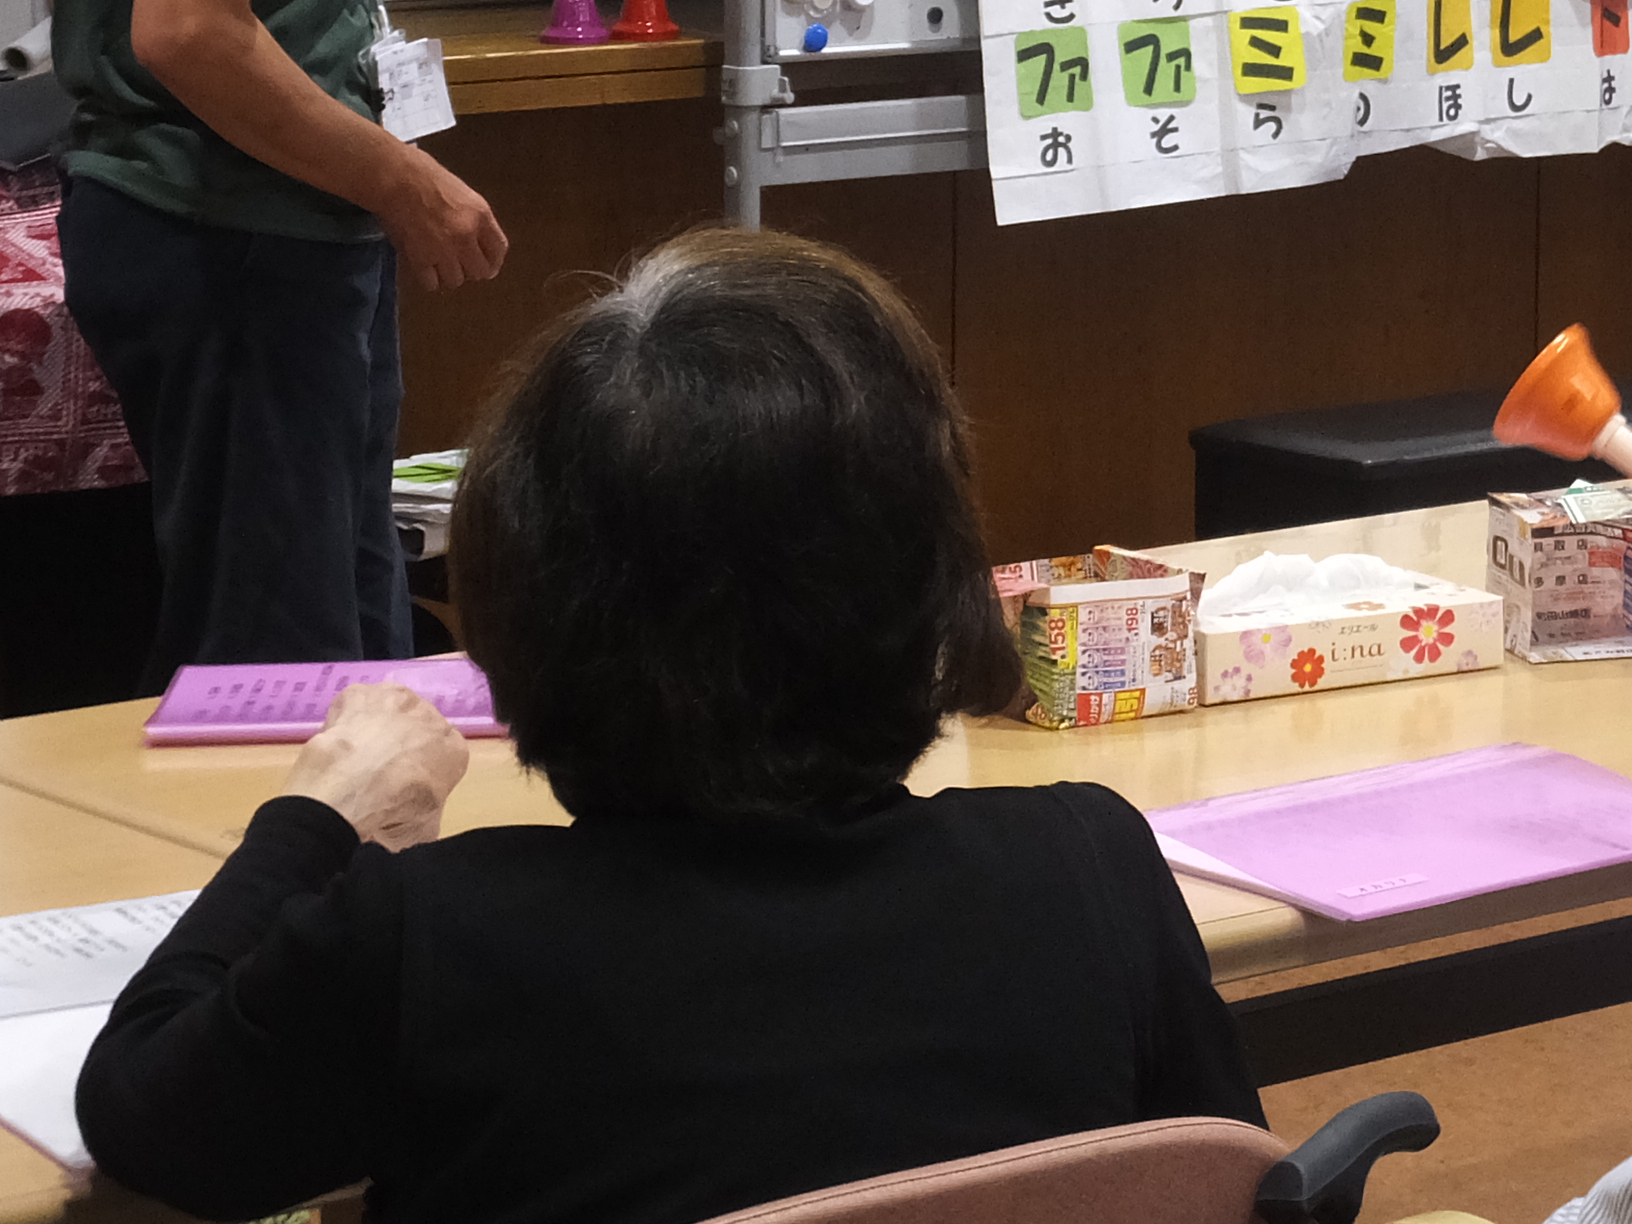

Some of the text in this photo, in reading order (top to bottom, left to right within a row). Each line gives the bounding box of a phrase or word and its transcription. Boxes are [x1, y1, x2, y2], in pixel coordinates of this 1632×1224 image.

[1016, 42, 1089, 106] ファ
[1123, 33, 1191, 97] ファ
[1239, 17, 1294, 82] ミ
[1350, 7, 1387, 72] ミ
[1434, 0, 1469, 64] レ
[1040, 127, 1073, 167] お
[1150, 115, 1179, 154] そ
[1252, 103, 1283, 140] ら
[1438, 84, 1462, 122] ほ
[1507, 78, 1532, 112] し
[1331, 641, 1385, 663] i:na
